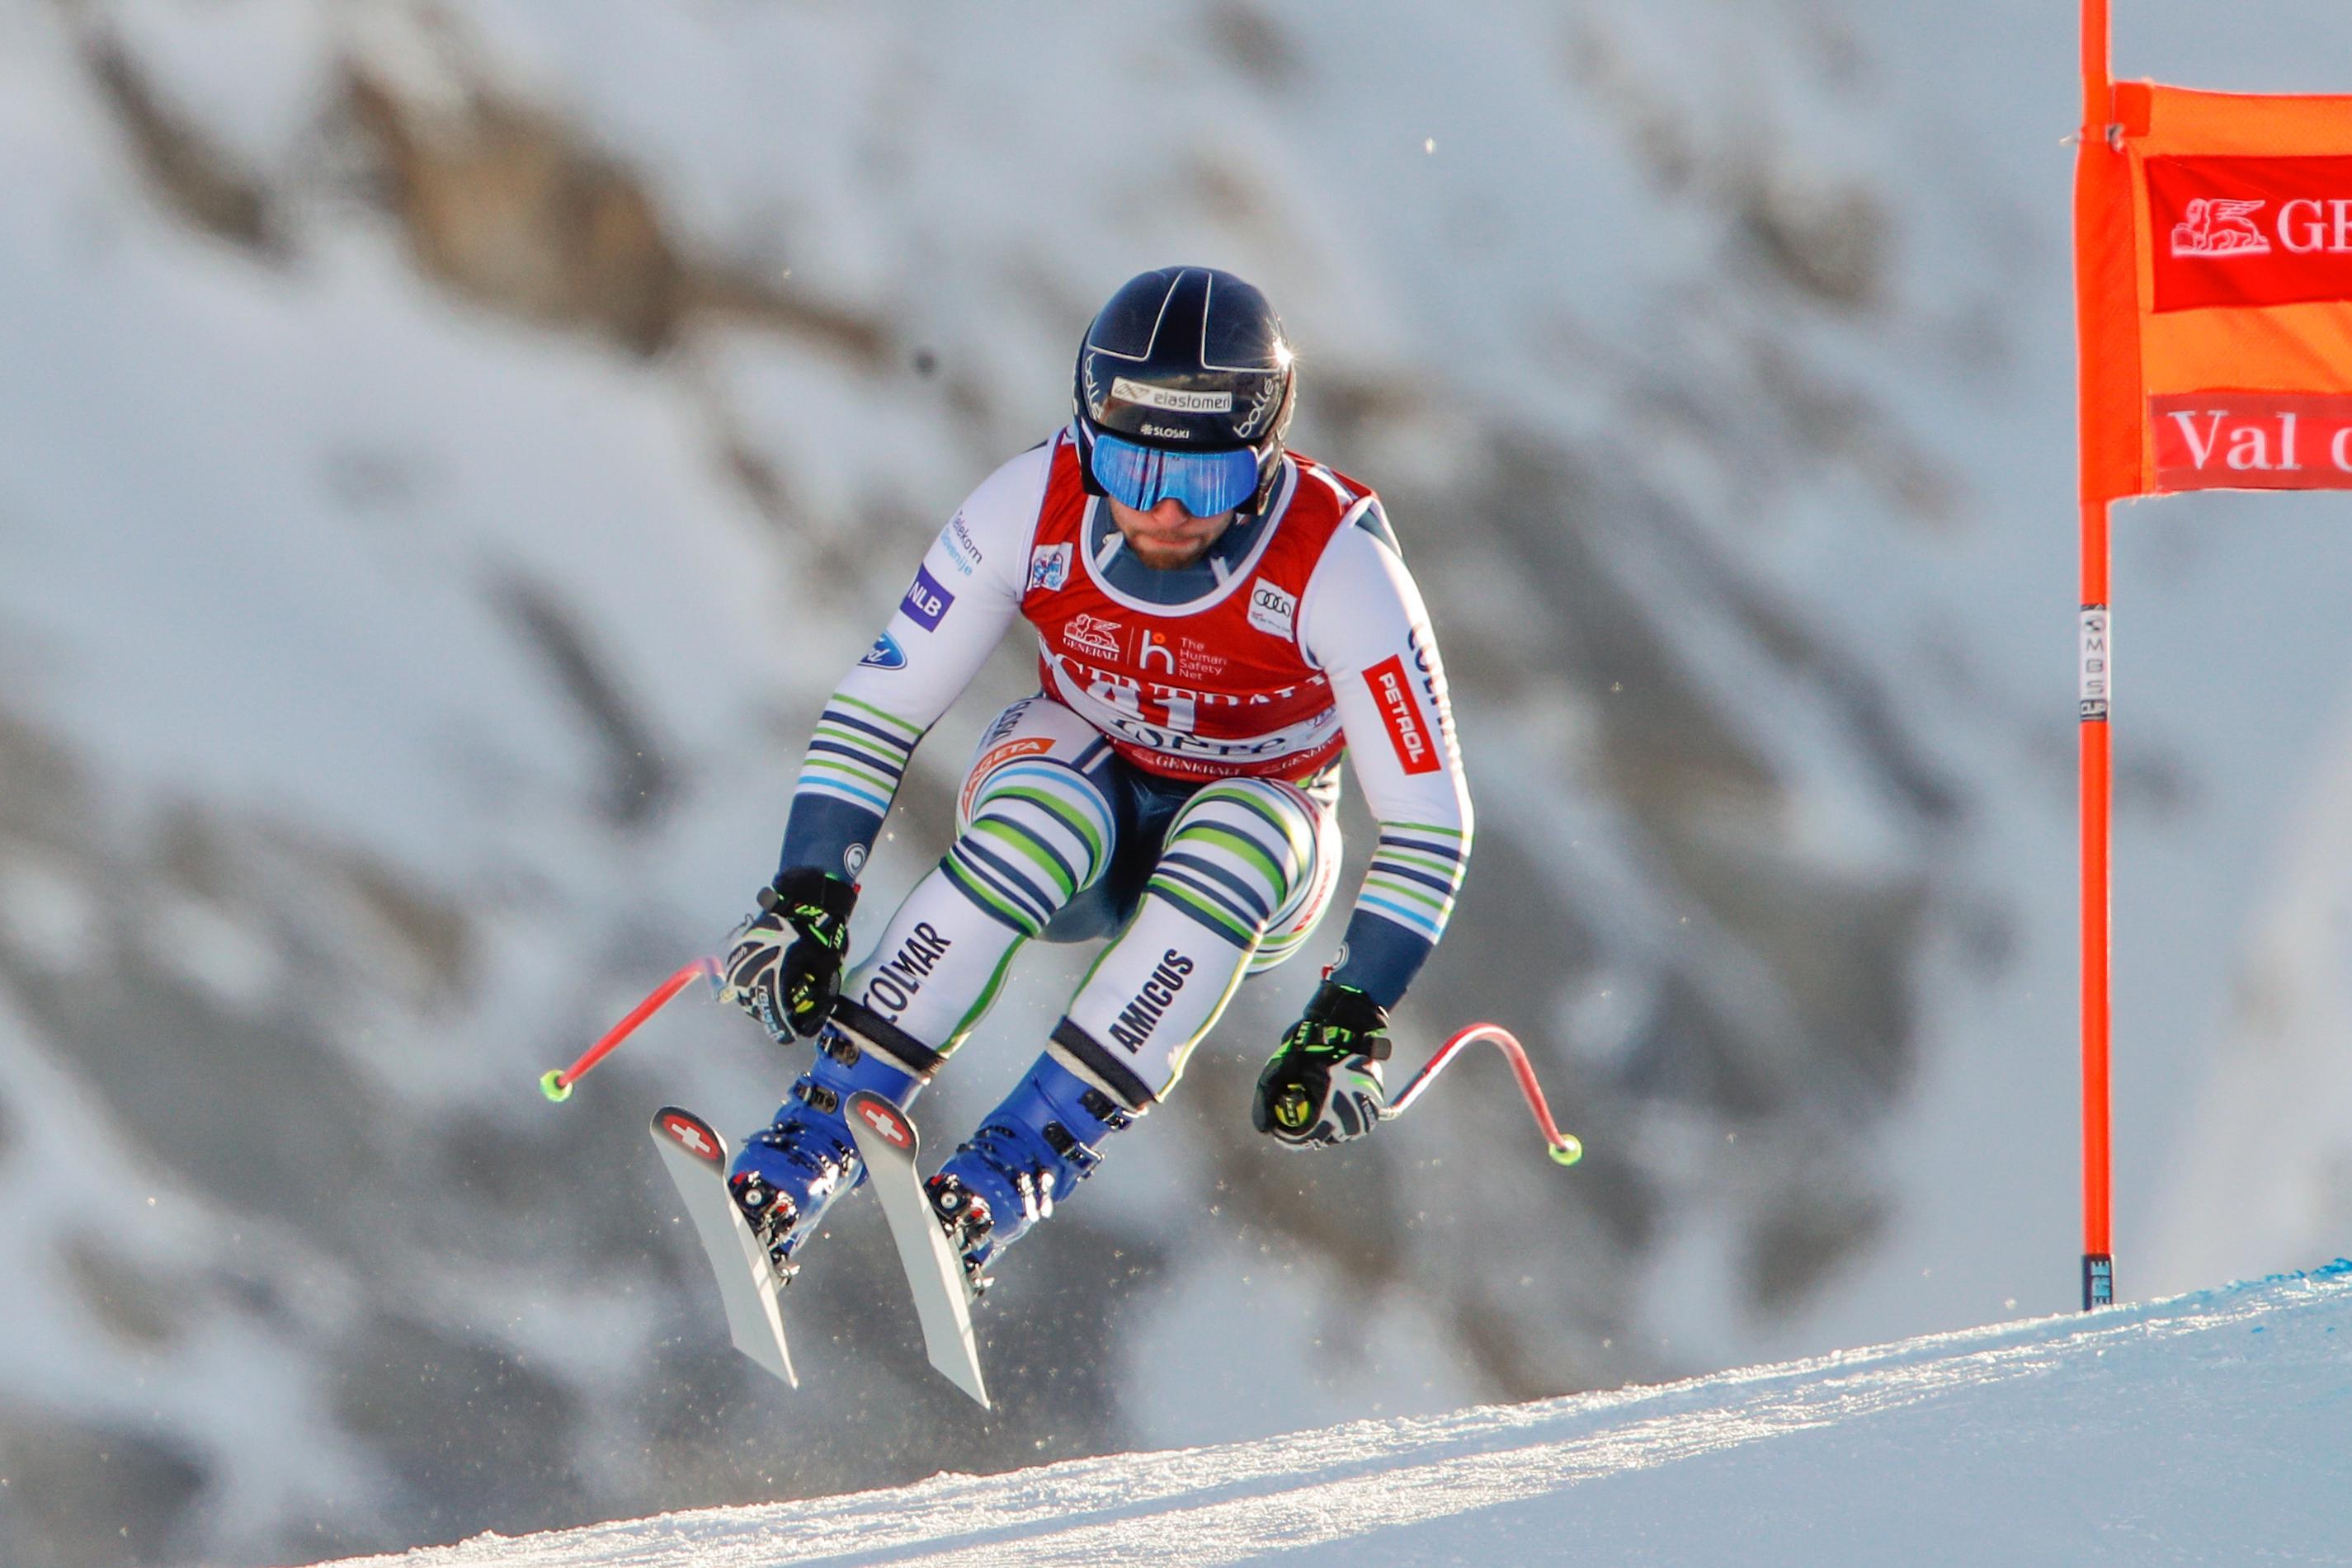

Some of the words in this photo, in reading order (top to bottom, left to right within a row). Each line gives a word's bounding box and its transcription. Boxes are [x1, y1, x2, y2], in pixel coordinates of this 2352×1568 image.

[1153, 391, 1230, 410] elastomeri
[1153, 426, 1190, 439] SLOSKI
[2166, 409, 2303, 471] Val
[908, 581, 942, 617] NLB
[1063, 637, 1119, 662] GENERALI
[1181, 637, 1204, 652] The
[1180, 648, 1228, 666] Human
[1180, 658, 1223, 676] Safety
[1180, 668, 1202, 680] Net
[1379, 672, 1426, 764] PETROL
[1156, 755, 1241, 777] GENERALI
[1108, 949, 1195, 1055] AMICUS
